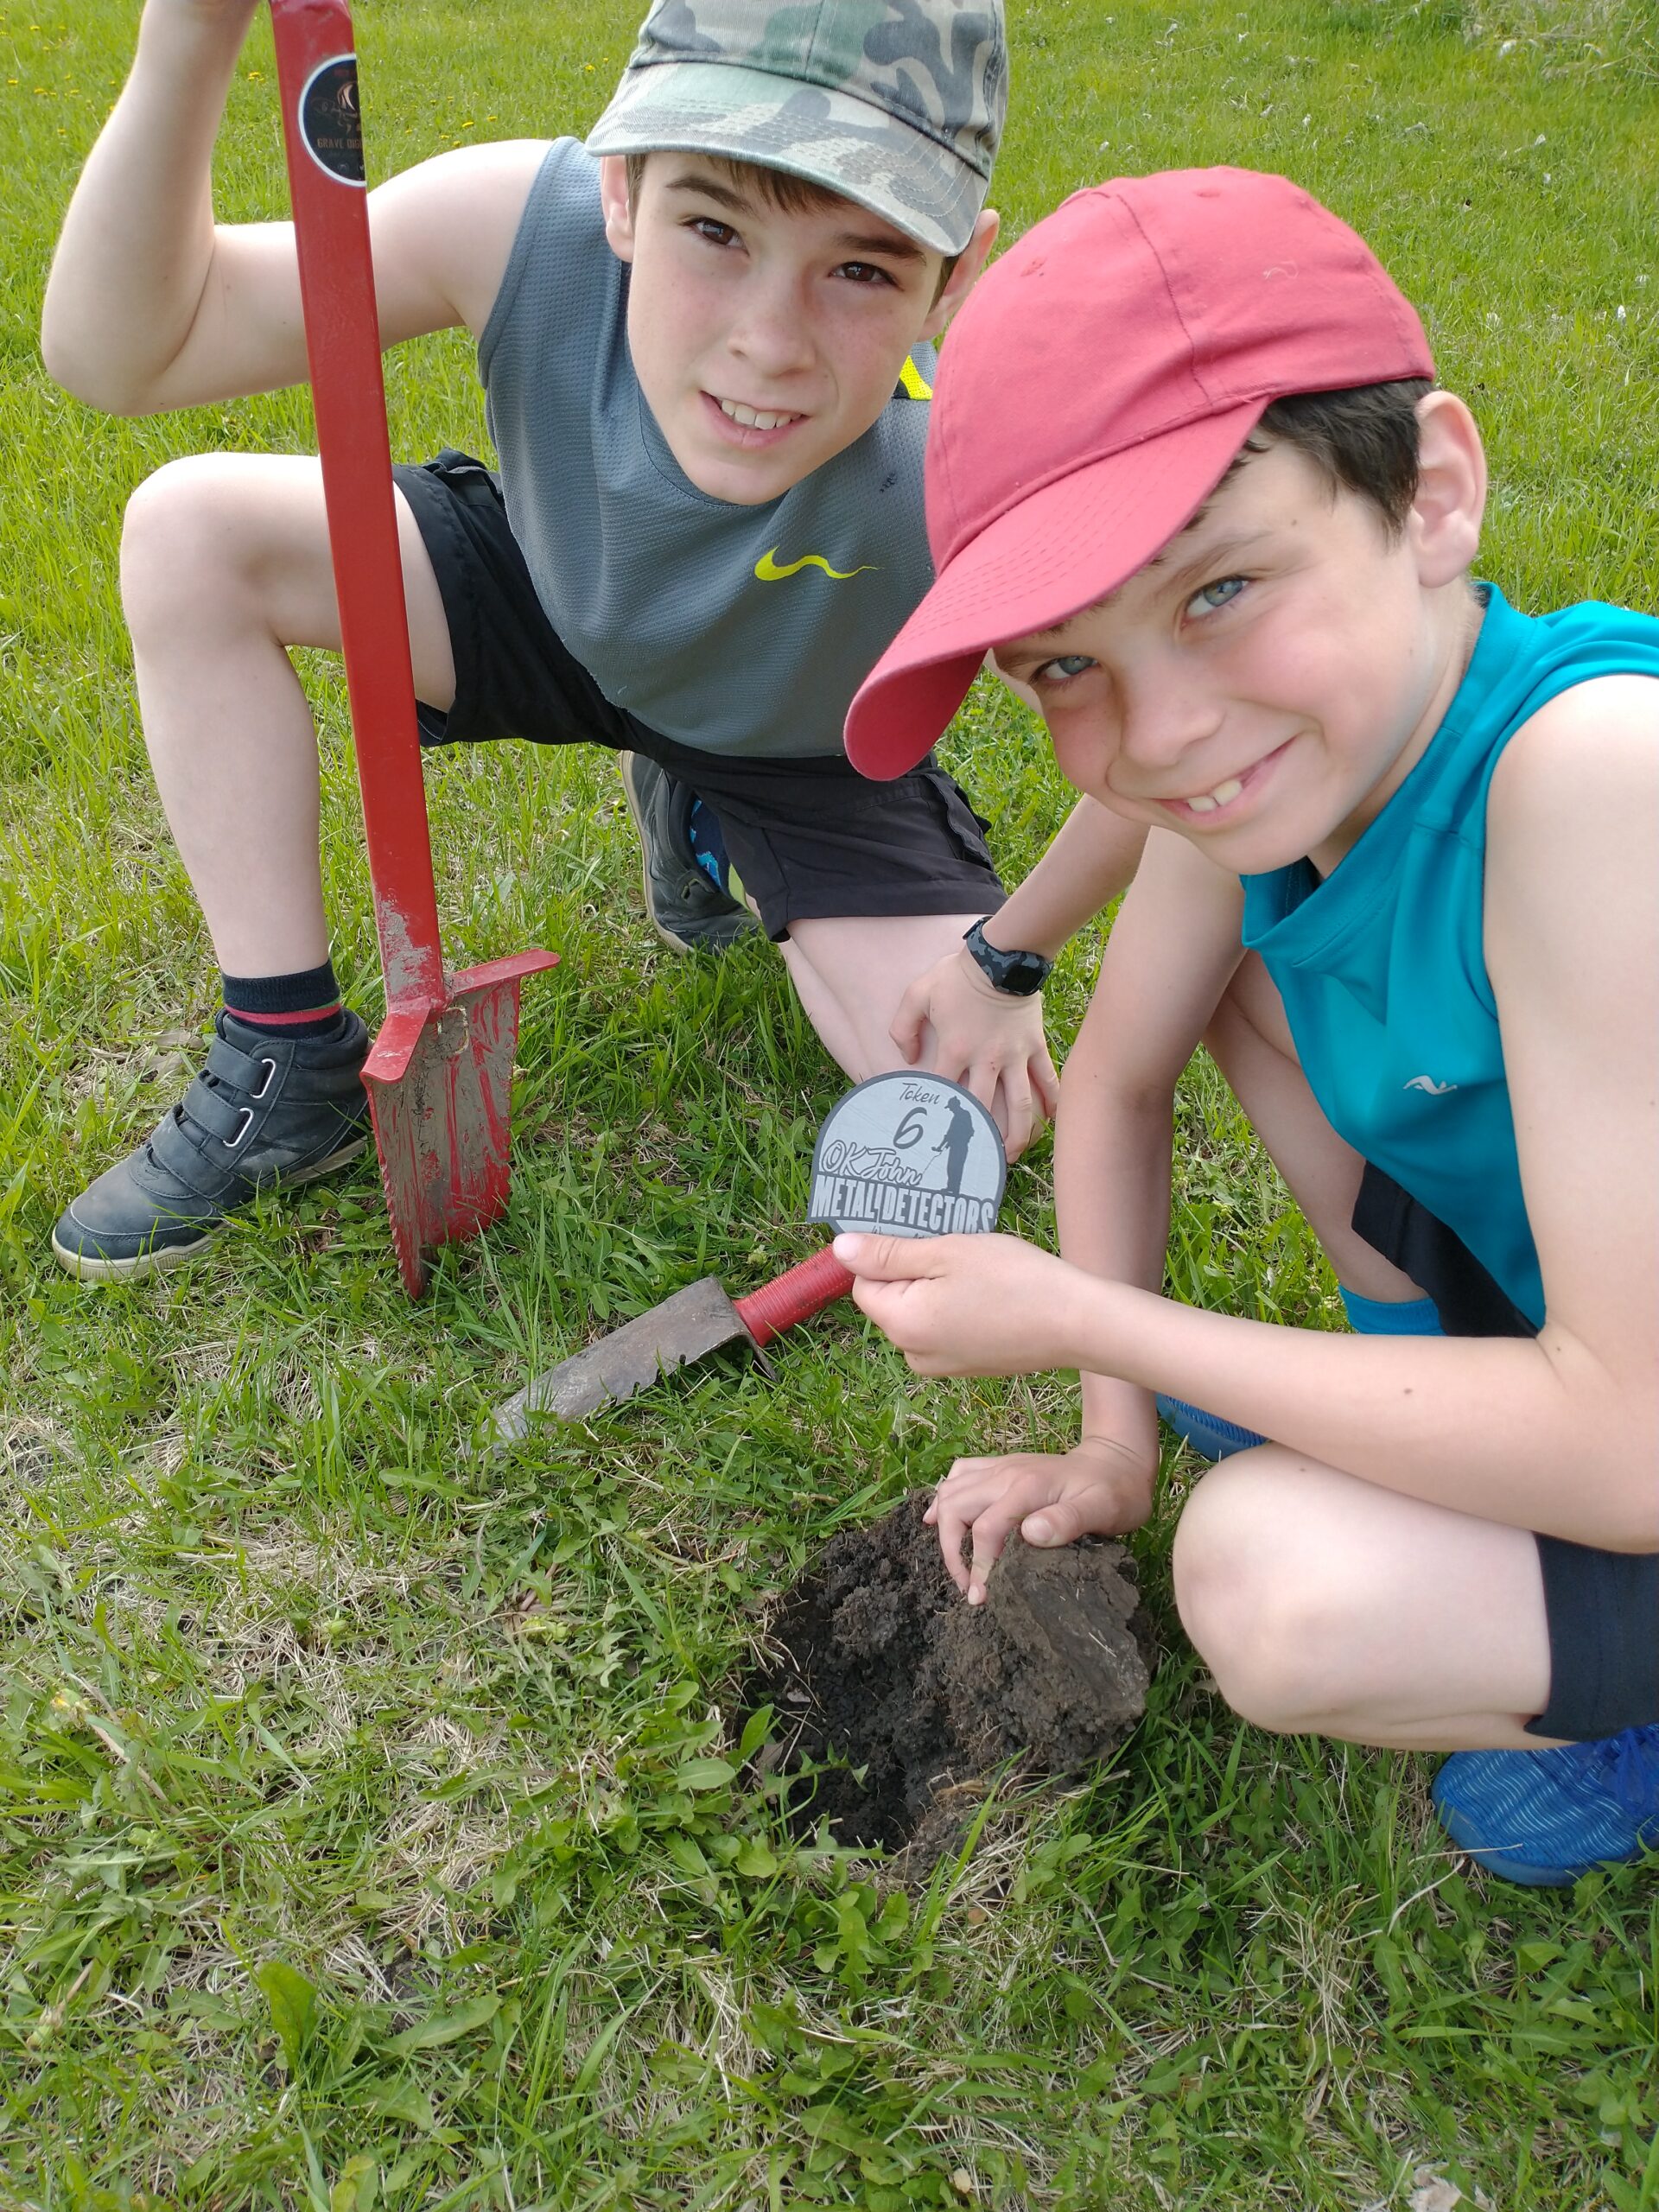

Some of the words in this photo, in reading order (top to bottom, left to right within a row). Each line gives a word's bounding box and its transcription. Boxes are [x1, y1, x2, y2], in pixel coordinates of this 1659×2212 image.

[317, 138, 344, 149] GRAVE
[346, 138, 362, 149] DIG
[899, 1082, 940, 1104] Token
[893, 1107, 927, 1149] 6
